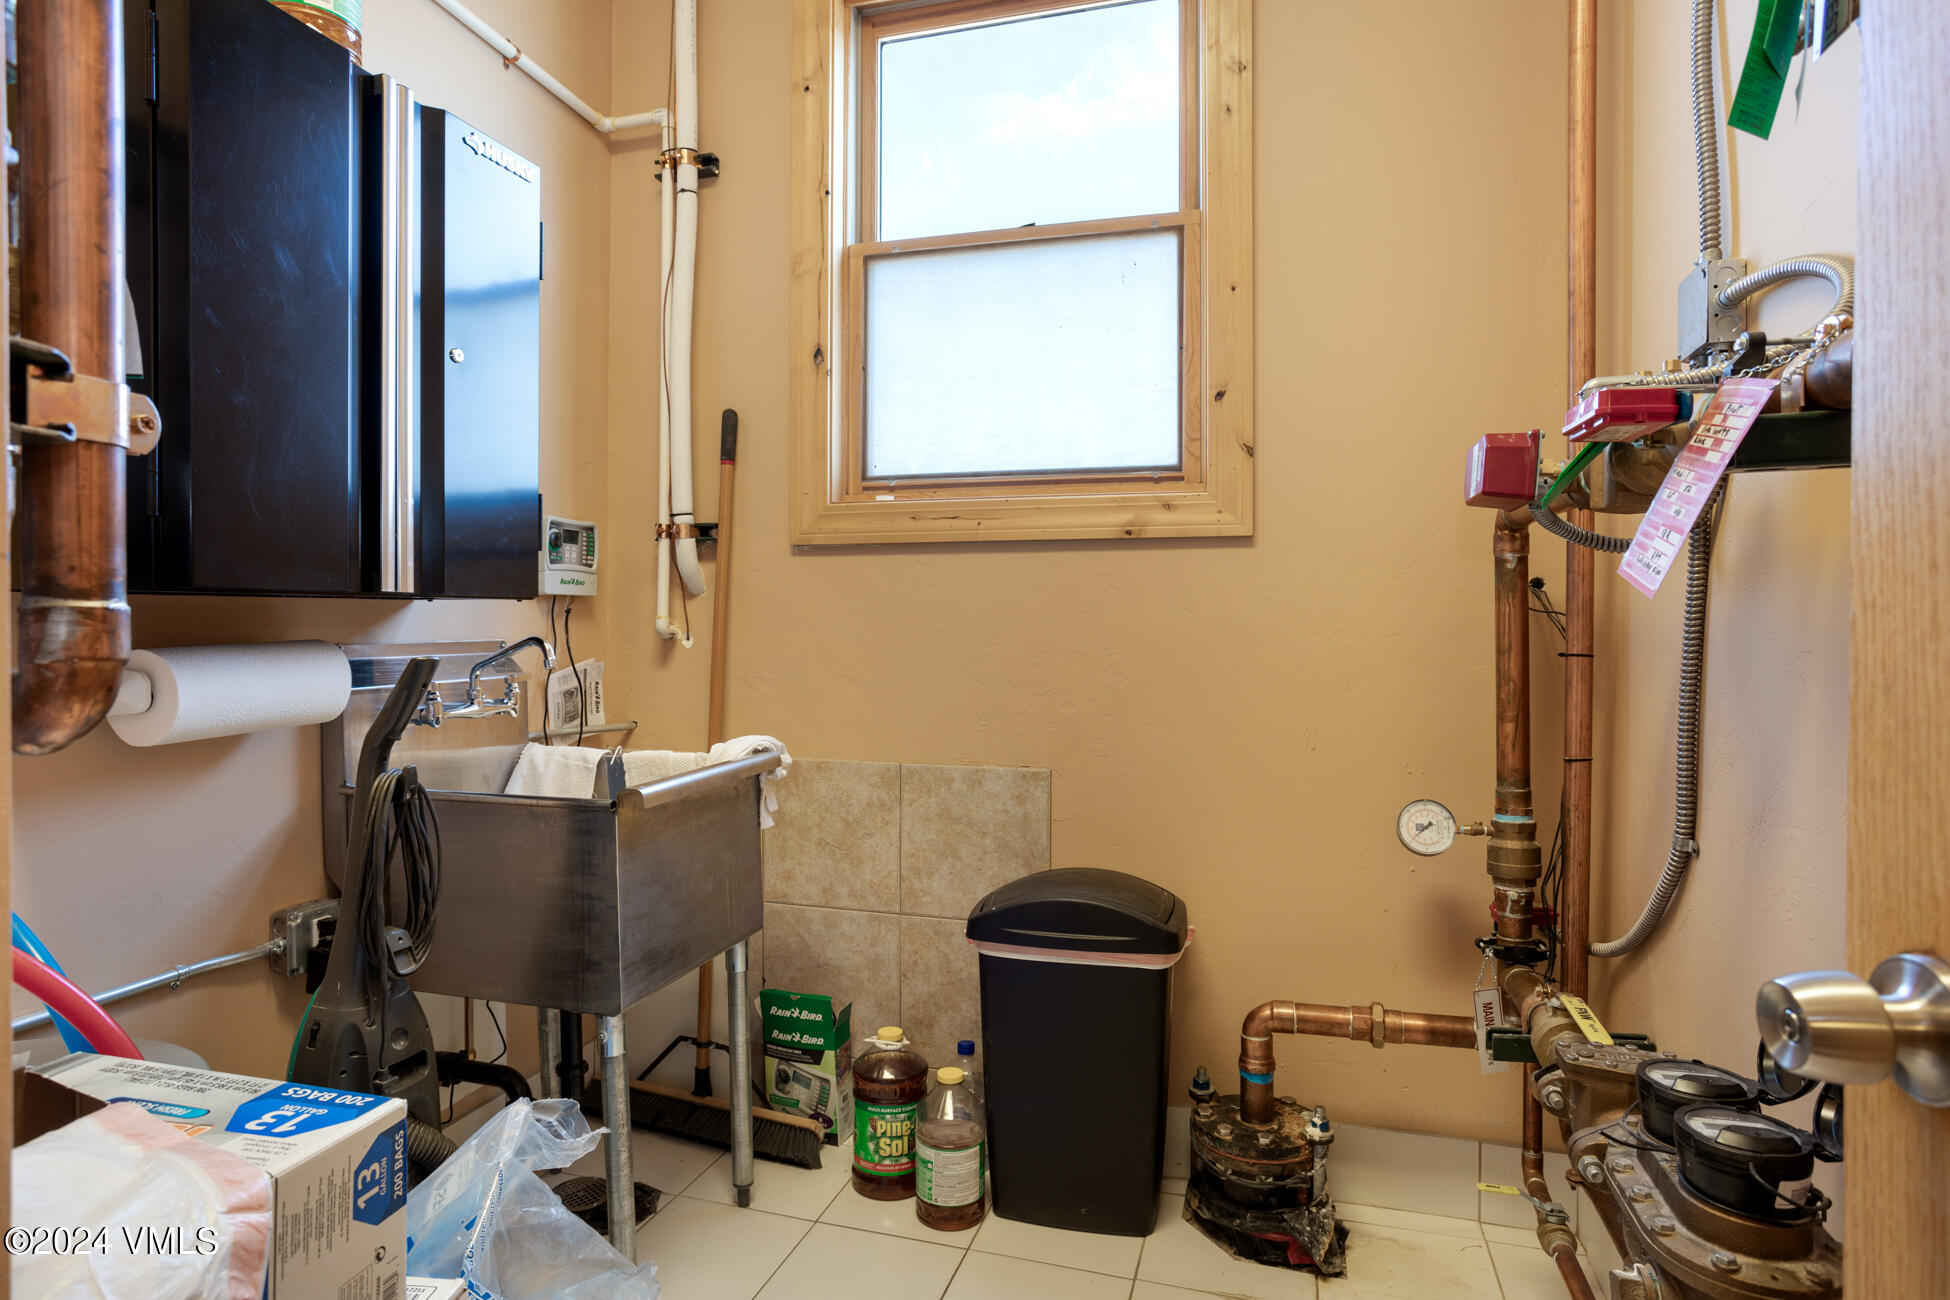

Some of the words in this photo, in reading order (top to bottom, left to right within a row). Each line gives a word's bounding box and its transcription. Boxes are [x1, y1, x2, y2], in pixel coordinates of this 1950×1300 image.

[484, 142, 535, 183] HUSKY
[770, 1006, 792, 1018] RAIN
[800, 1010, 823, 1021] BIRD
[1482, 1002, 1496, 1026] MAIN
[772, 1029, 792, 1042] RAIN
[801, 1034, 824, 1046] BIRD
[281, 1087, 334, 1102] BAGS
[335, 1094, 375, 1106] 200
[280, 1104, 329, 1115] GALLON
[244, 1110, 312, 1132] 13
[394, 1130, 404, 1170] BAGS
[880, 1136, 908, 1157] Sol
[357, 1162, 380, 1209] 13
[394, 1172, 404, 1200] 200
